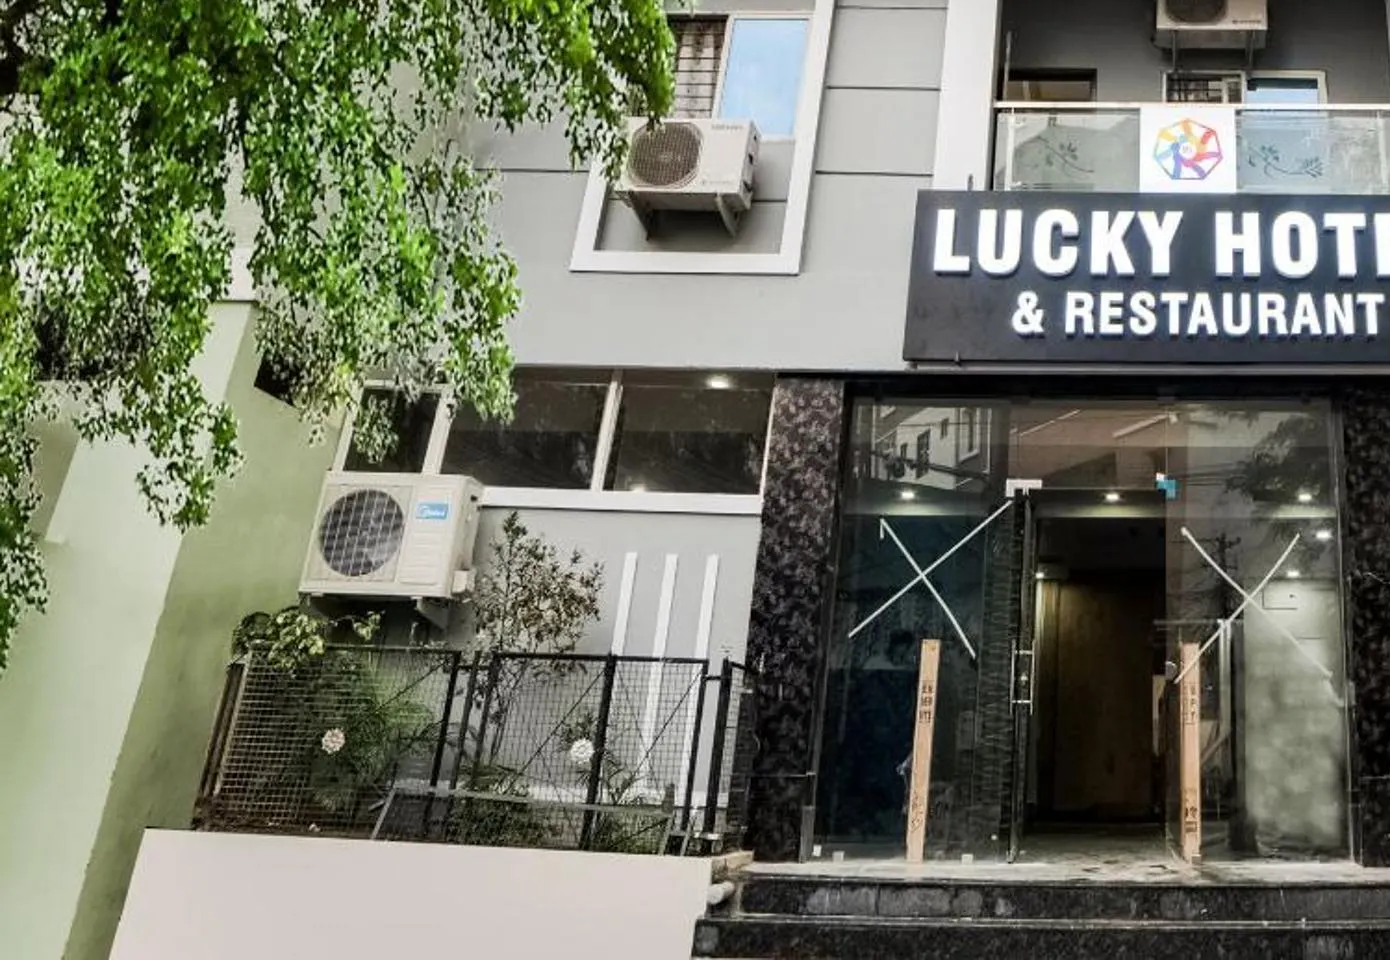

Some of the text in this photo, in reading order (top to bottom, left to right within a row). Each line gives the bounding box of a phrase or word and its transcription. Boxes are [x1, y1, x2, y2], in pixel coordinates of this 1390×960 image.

[933, 209, 1183, 275] LUCKY
[1012, 291, 1385, 335] & RESTAURANT
